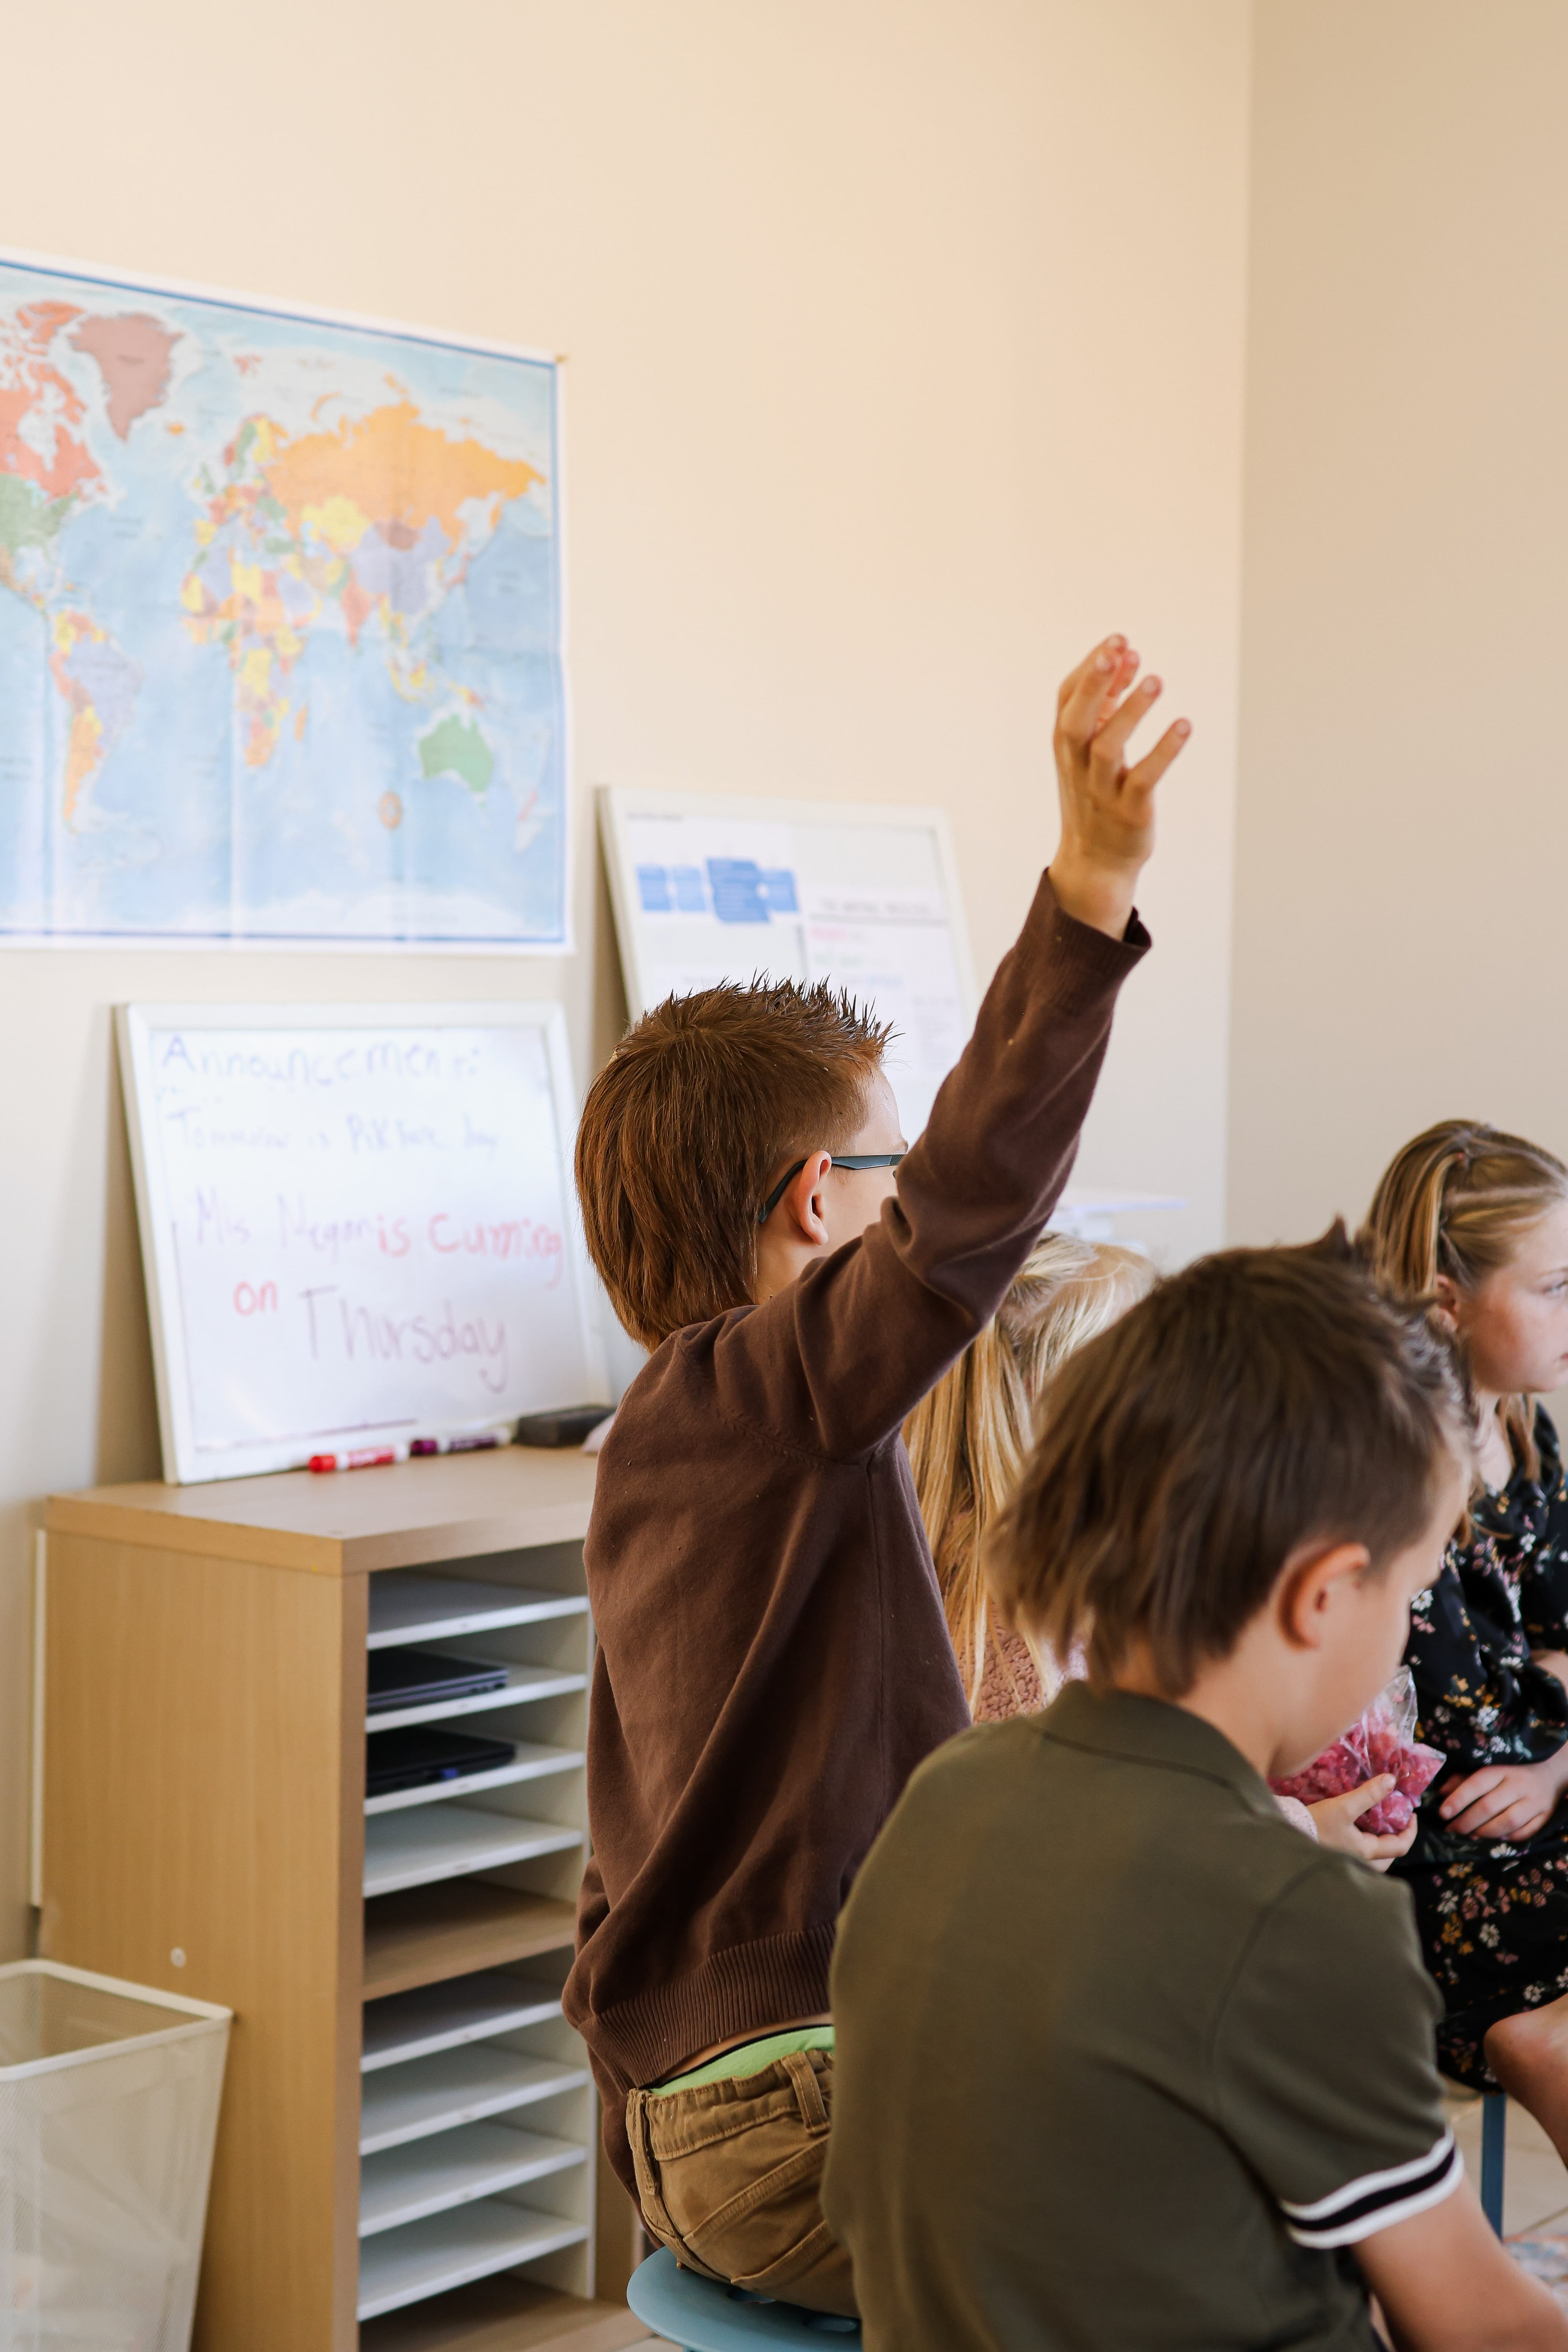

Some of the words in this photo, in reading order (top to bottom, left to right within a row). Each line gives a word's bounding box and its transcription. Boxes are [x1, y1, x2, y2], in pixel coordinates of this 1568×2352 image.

[376, 1213, 411, 1258] is
[232, 1280, 279, 1317] on
[297, 1283, 509, 1395] Thursday
